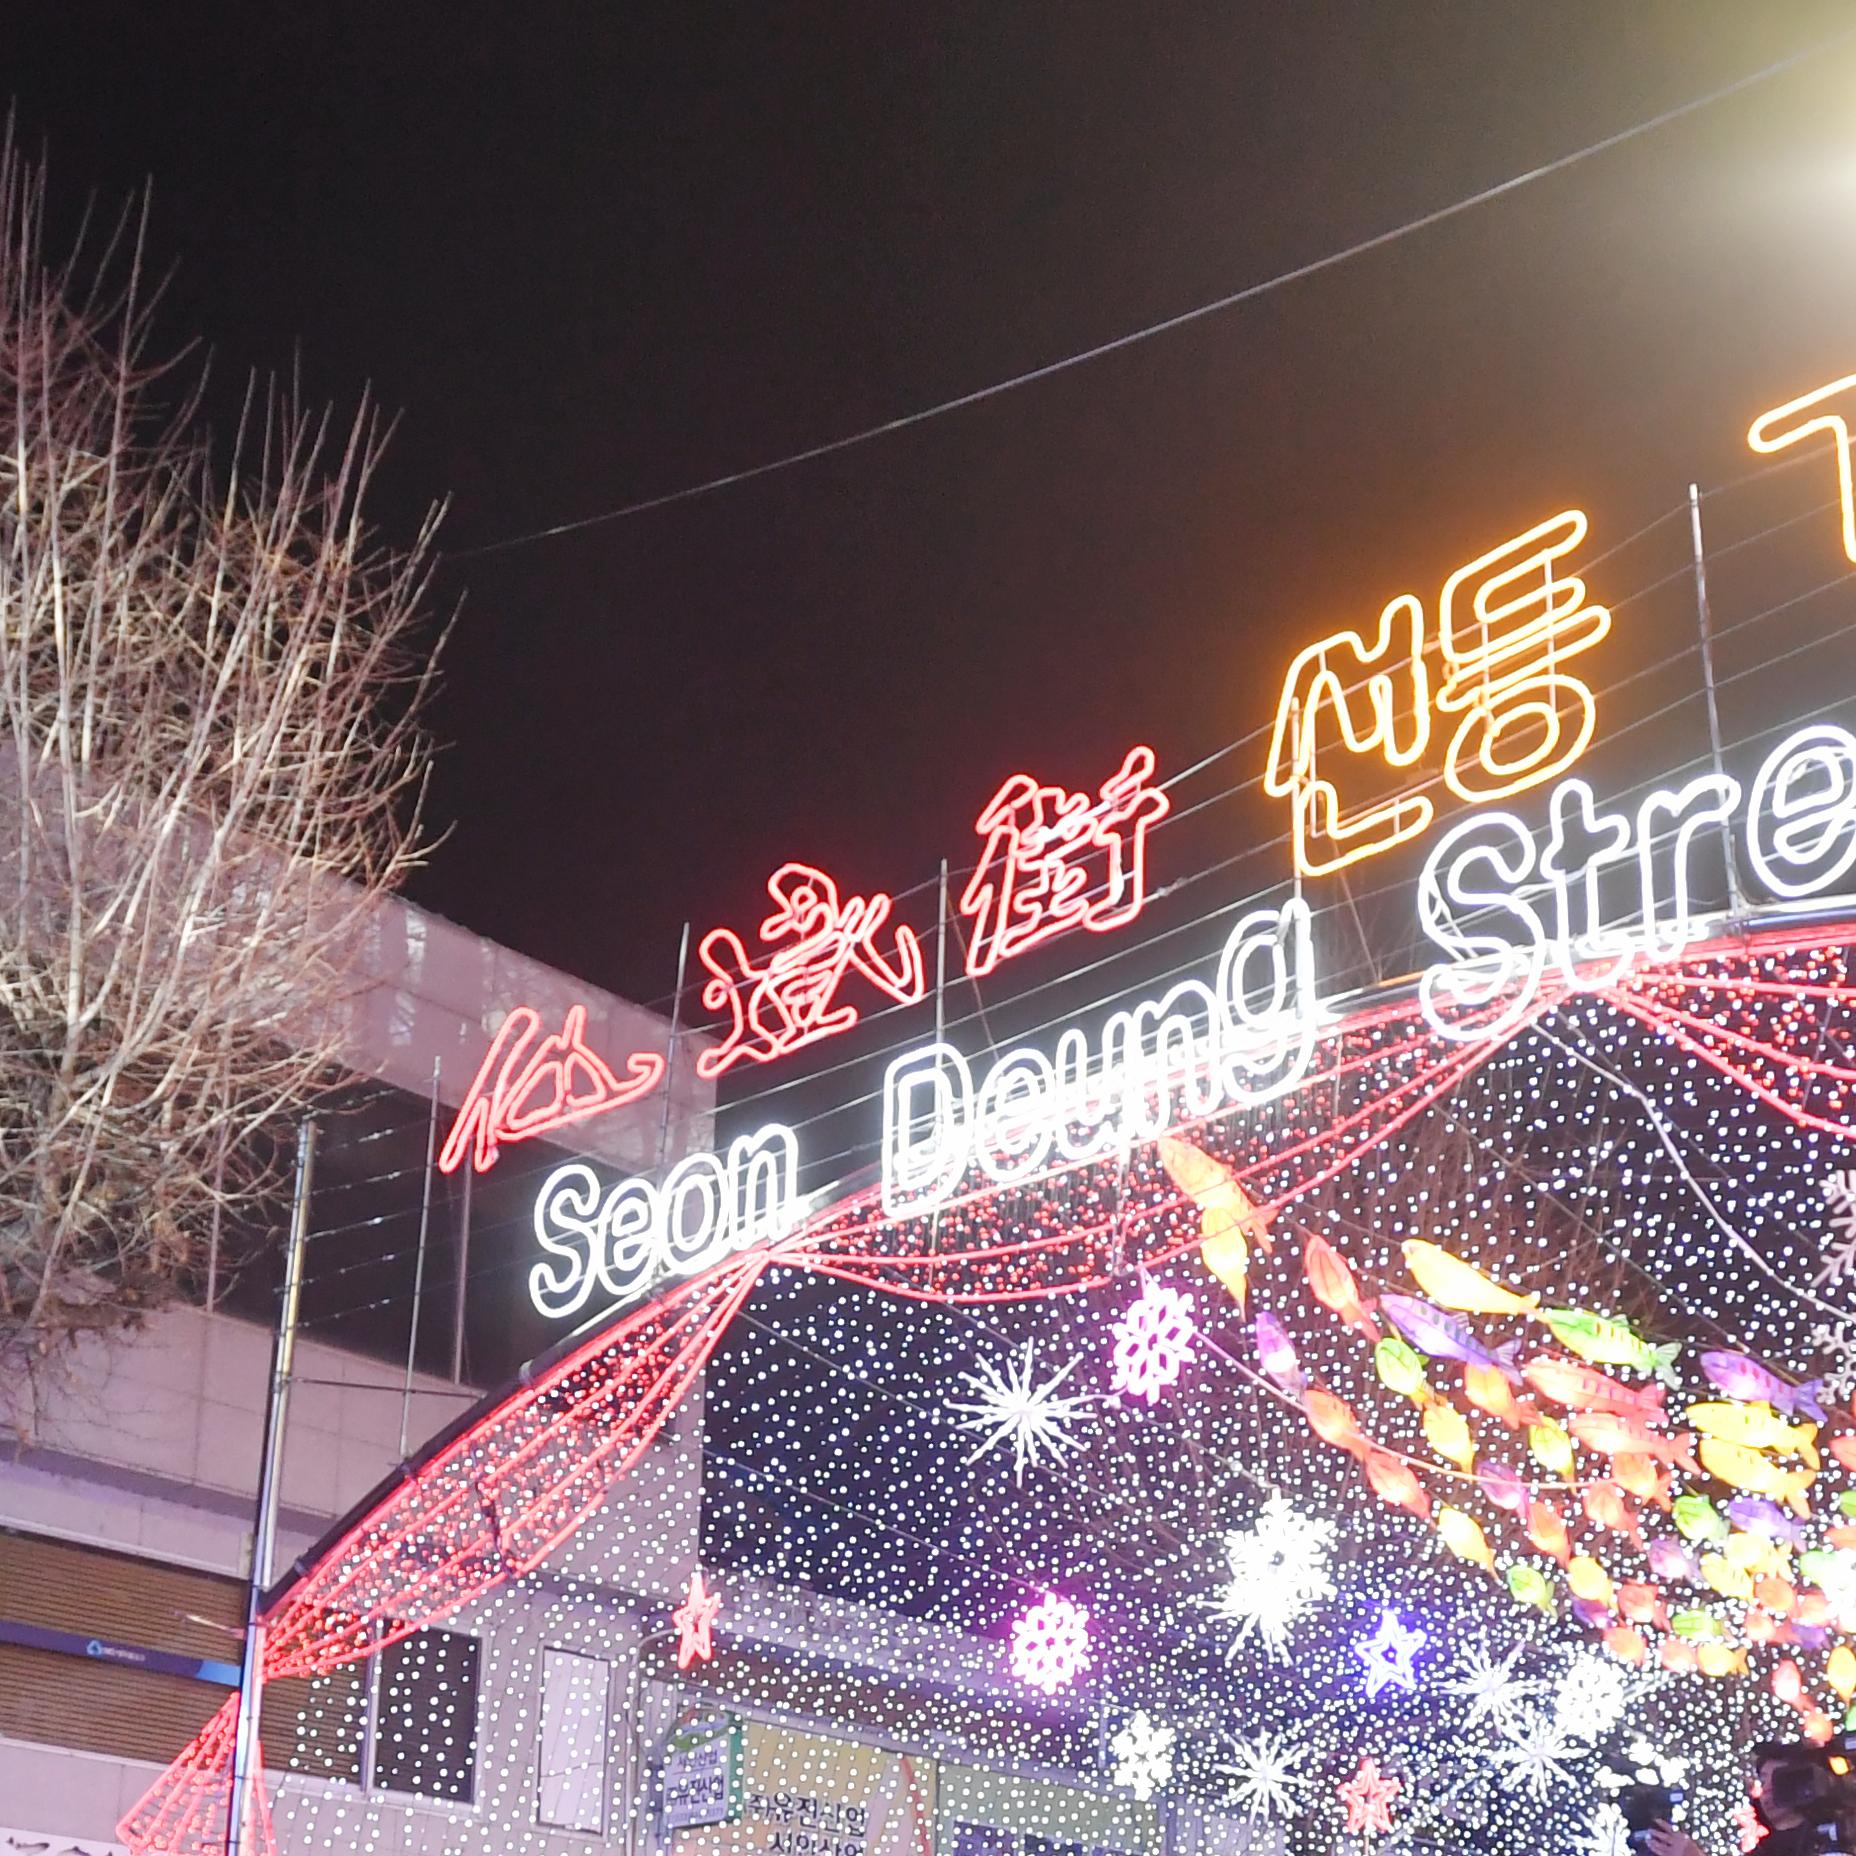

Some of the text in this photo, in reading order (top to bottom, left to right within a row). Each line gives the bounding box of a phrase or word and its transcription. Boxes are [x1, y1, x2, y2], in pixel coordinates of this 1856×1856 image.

[1263, 507, 1612, 877] 선등
[529, 1122, 801, 1320] Seon
[880, 896, 1320, 1218] Deung
